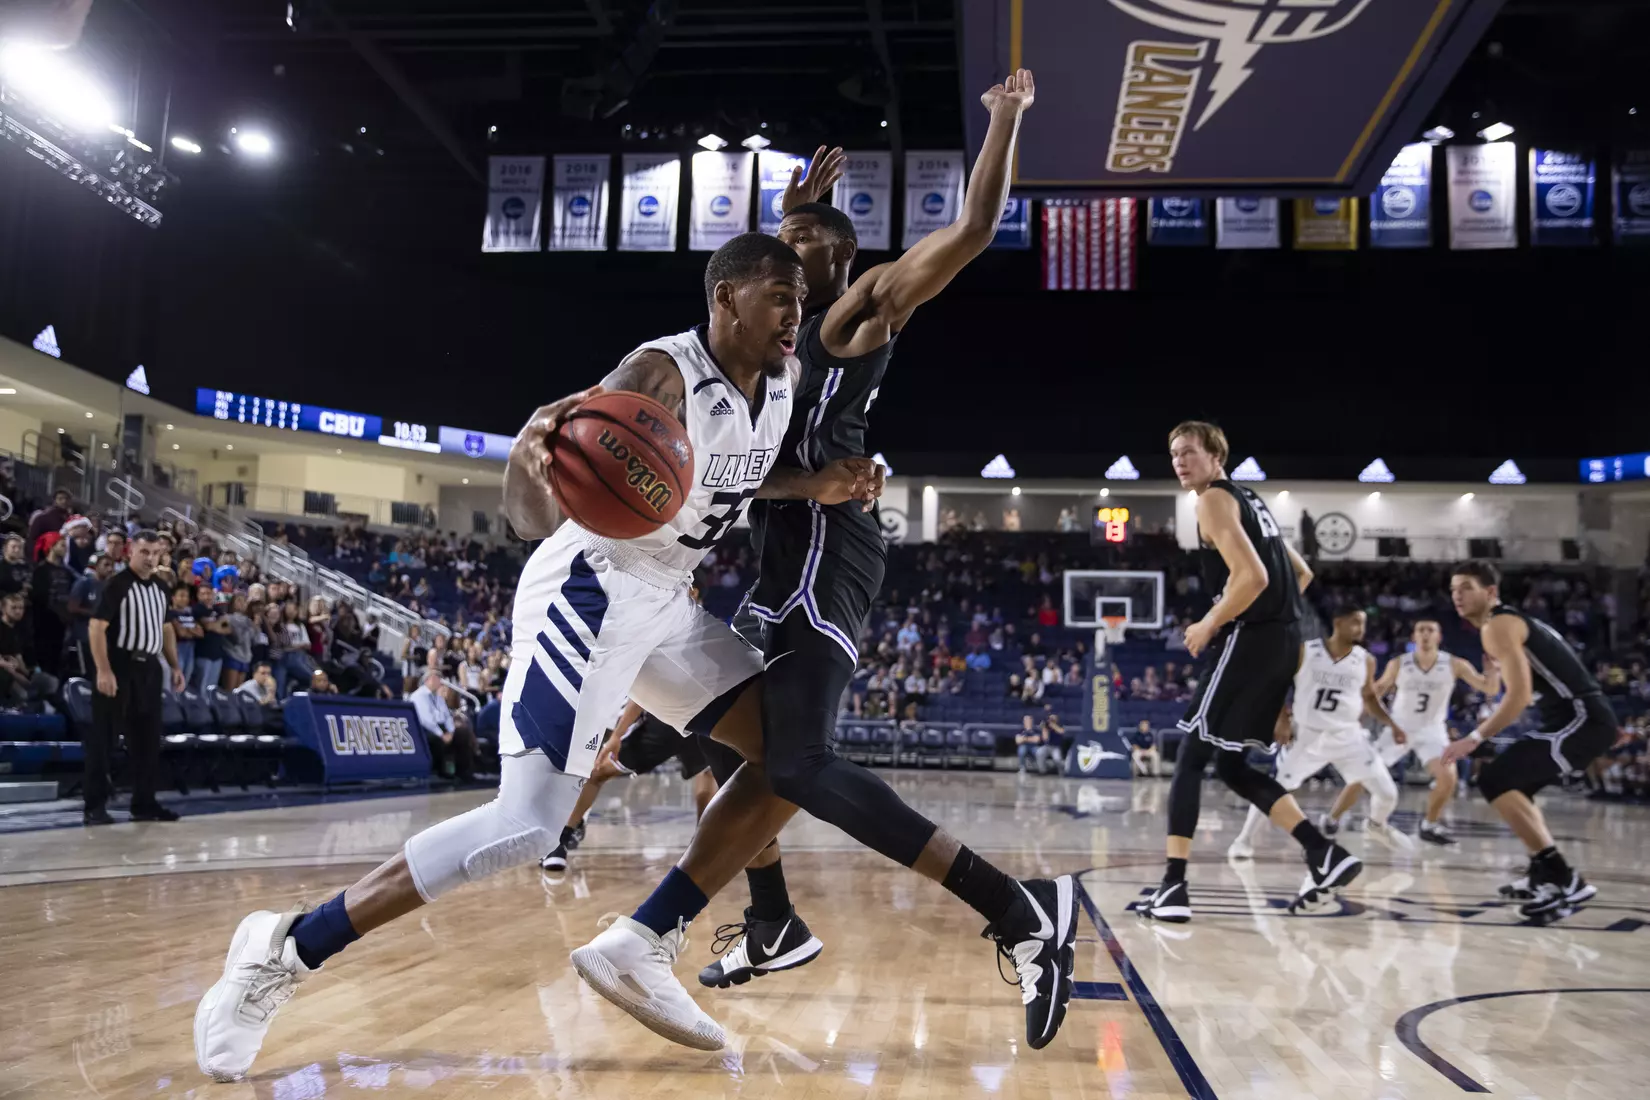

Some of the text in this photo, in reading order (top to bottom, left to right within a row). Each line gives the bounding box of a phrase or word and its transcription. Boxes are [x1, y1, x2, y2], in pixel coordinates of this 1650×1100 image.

[1105, 40, 1210, 173] LANCERS
[318, 410, 366, 438] CBU
[710, 408, 735, 417] adidas
[597, 428, 674, 514] Wilson
[1313, 687, 1343, 712] 15
[1414, 692, 1430, 713] 3
[324, 714, 416, 756] LANCERS
